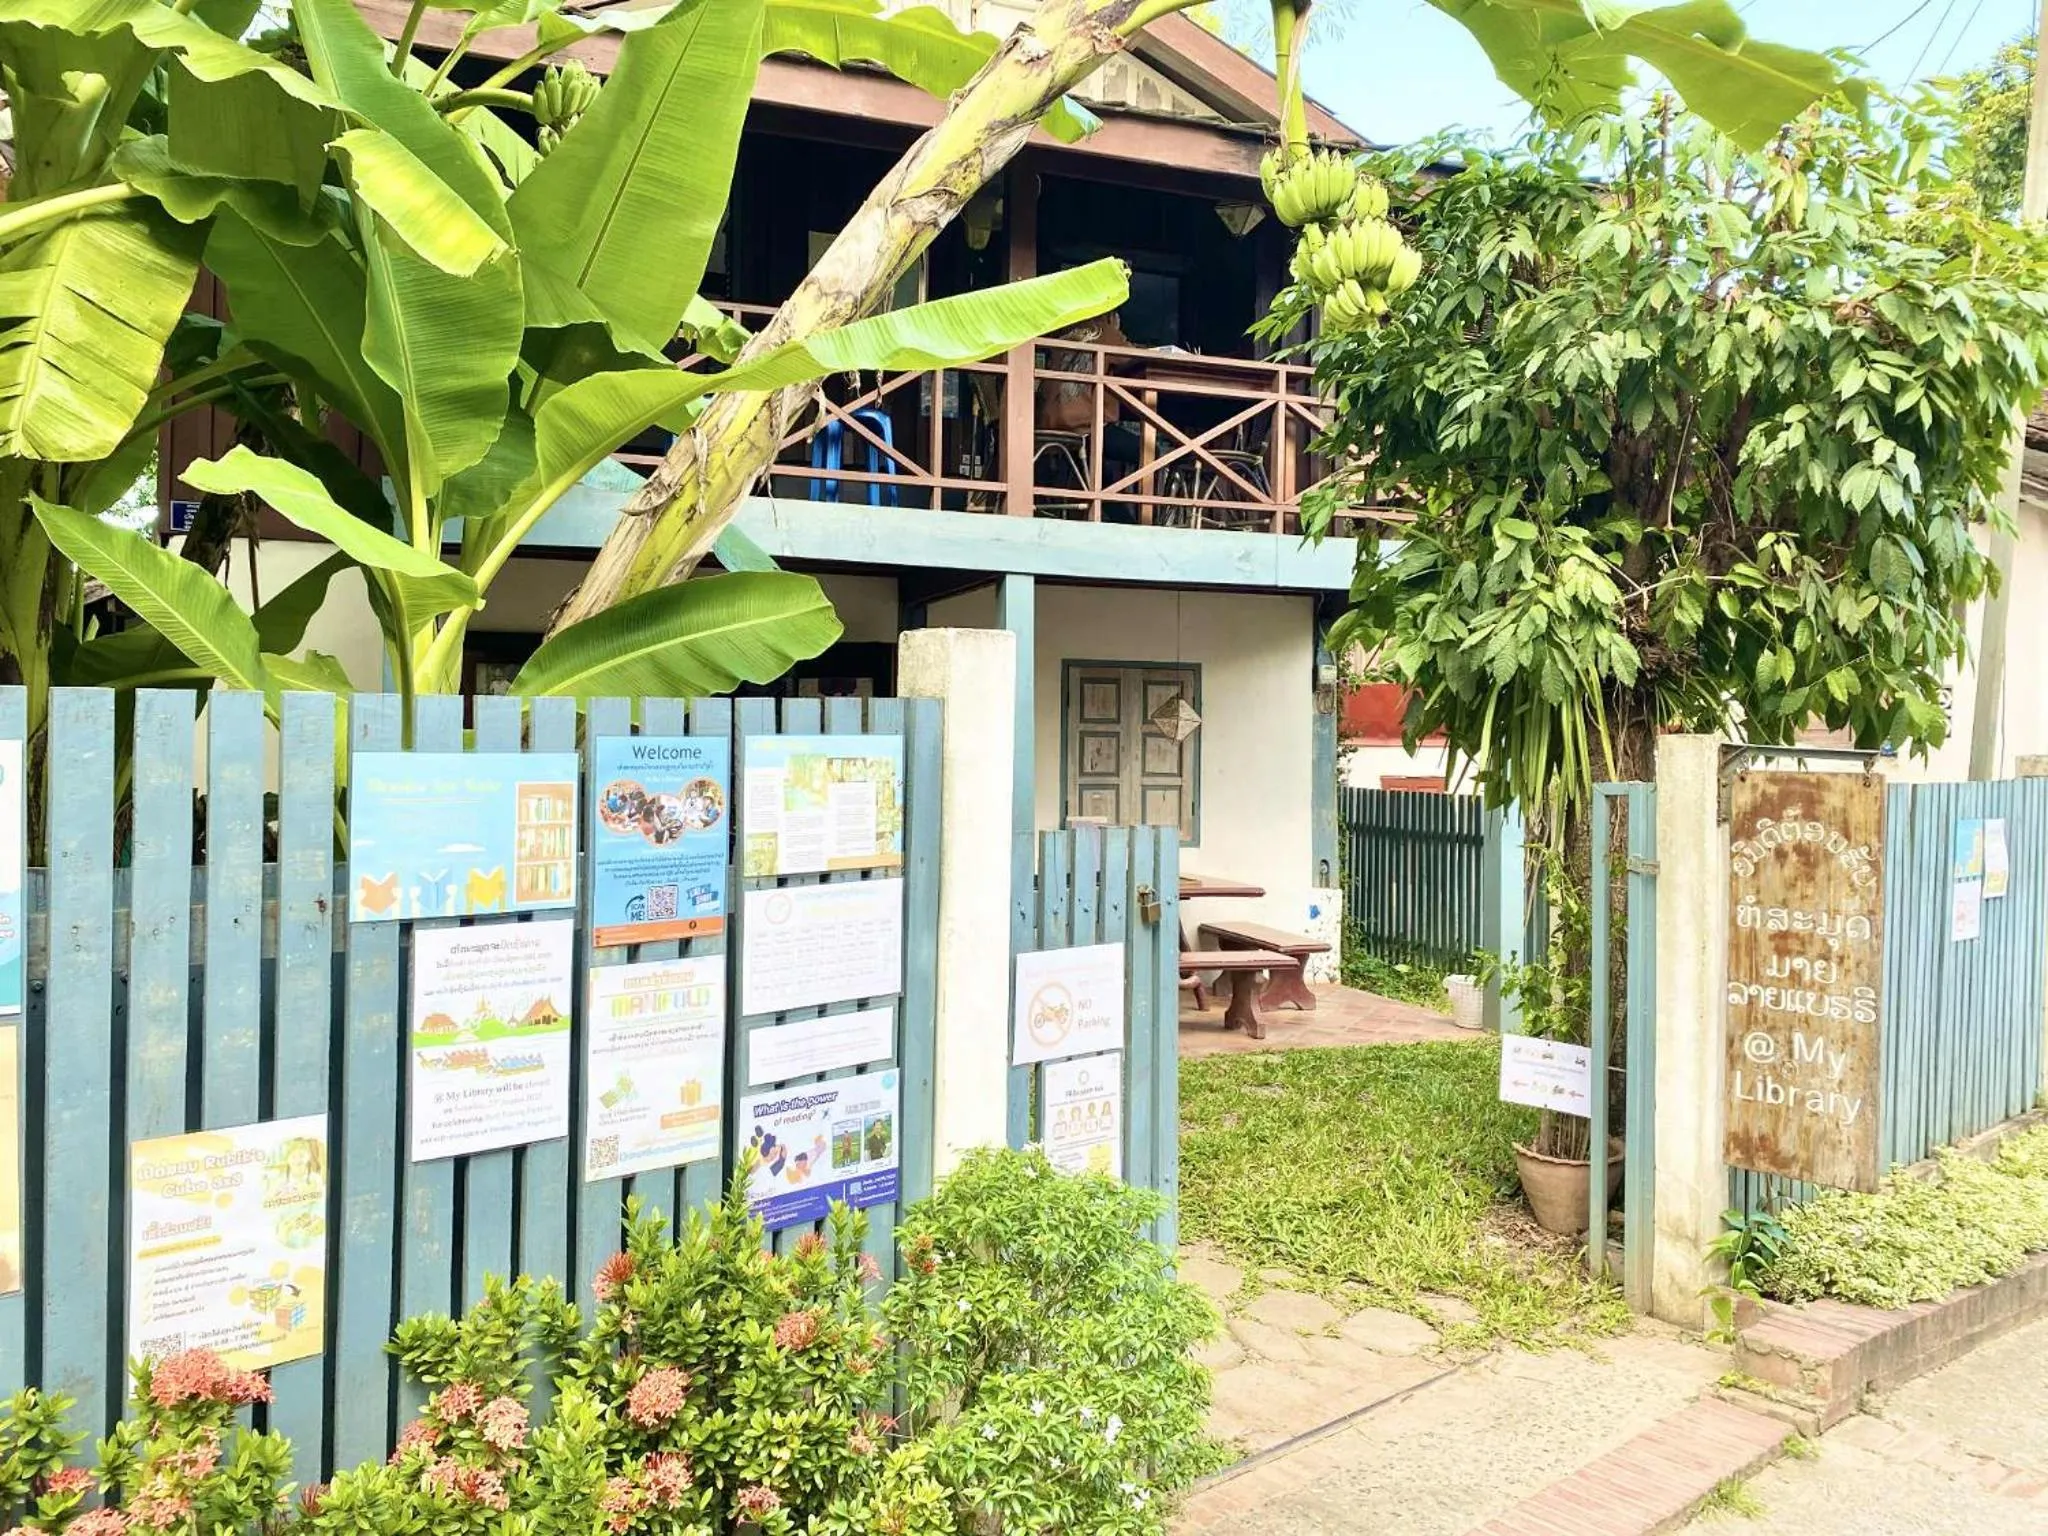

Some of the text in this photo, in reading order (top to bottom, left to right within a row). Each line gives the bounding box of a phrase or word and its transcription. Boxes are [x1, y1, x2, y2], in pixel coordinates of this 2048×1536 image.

[632, 745, 702, 760] Welcome
[1078, 1014, 1111, 1029] Parking
[1744, 1031, 1846, 1079] @ My
[446, 1091, 460, 1102] My
[463, 1086, 494, 1098] Library
[496, 1082, 511, 1093] will
[753, 1101, 780, 1118] What
[789, 1096, 808, 1110] the
[806, 1090, 840, 1109] power
[1735, 1070, 1861, 1125] Library
